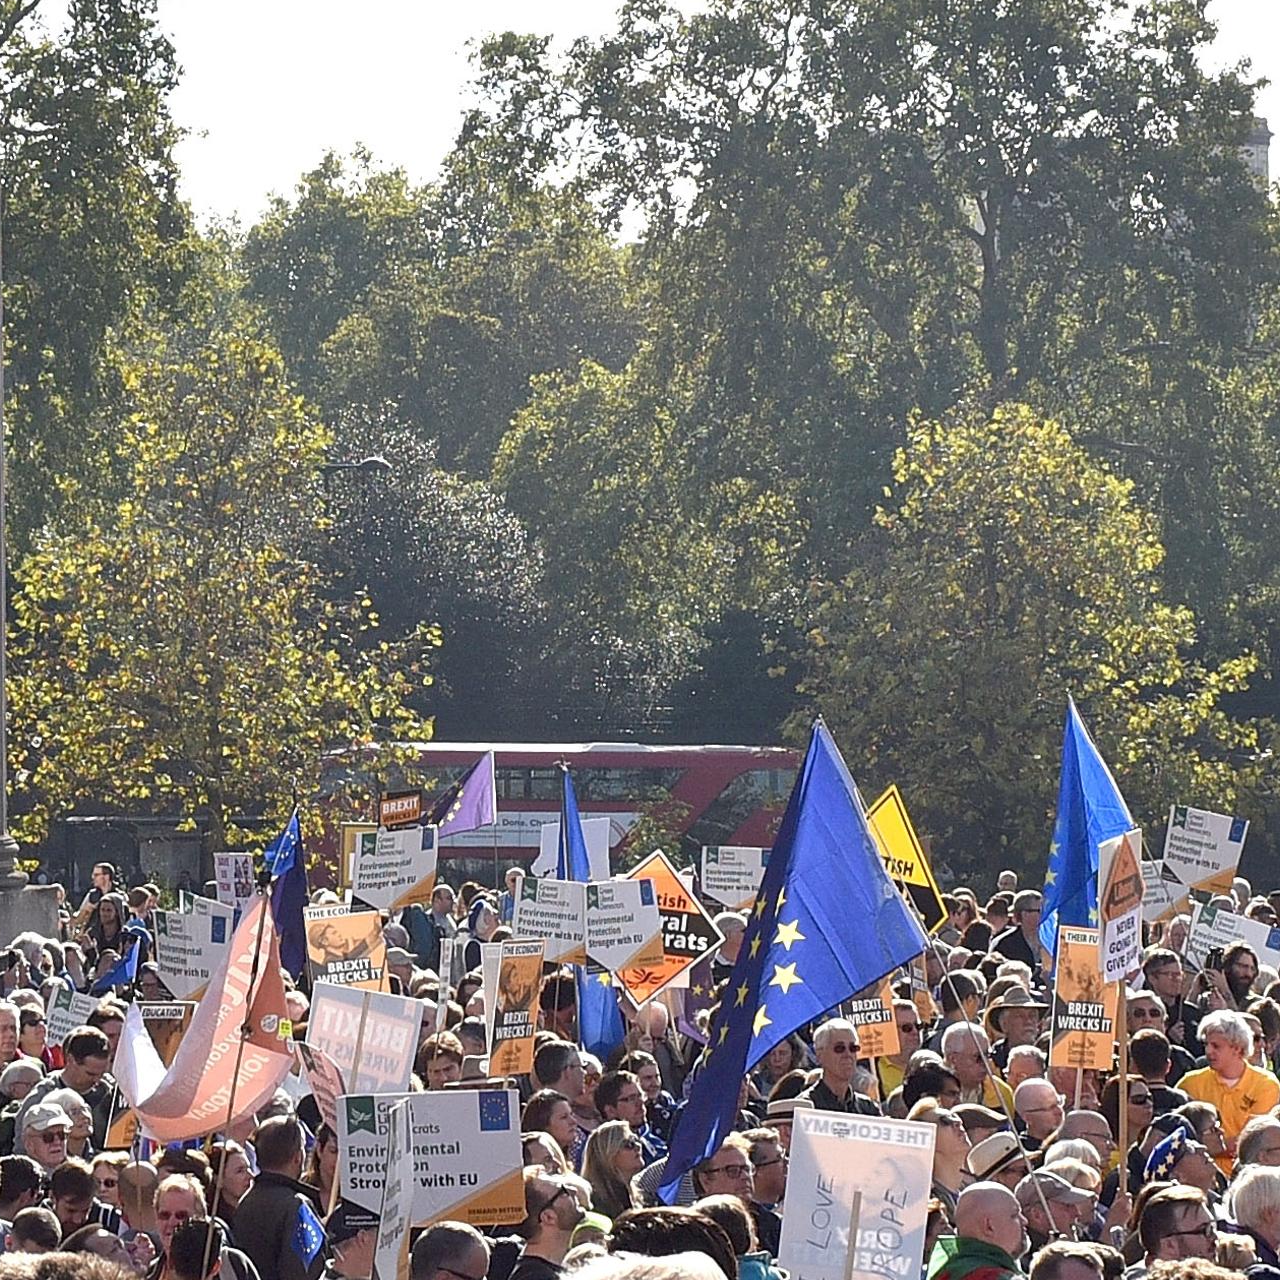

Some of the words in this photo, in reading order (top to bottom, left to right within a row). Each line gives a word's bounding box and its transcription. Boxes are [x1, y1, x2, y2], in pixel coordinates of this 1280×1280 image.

[383, 796, 419, 814] BREXIT
[882, 855, 914, 877] TISH
[357, 879, 390, 890] Stronger
[658, 894, 687, 909] tish
[308, 910, 325, 919] THE
[519, 907, 578, 921] Environmental
[587, 914, 634, 927] Environmental
[518, 918, 560, 929] Protection
[517, 927, 552, 939] Stronger
[573, 932, 583, 941] EU
[588, 926, 621, 937] Protection
[1067, 933, 1087, 942] THEIR
[504, 946, 515, 954] THE
[515, 943, 542, 953] ECONOMY
[588, 937, 615, 948] Stronger
[633, 935, 643, 943] EU
[328, 958, 370, 974] BREXIT
[1107, 955, 1125, 972] GIVE
[318, 970, 369, 985] WRECKS
[371, 968, 382, 980] IT
[852, 999, 882, 1011] BREXIT
[1068, 1002, 1104, 1018] BREXIT
[141, 1008, 183, 1017] EDUCATION
[503, 1011, 529, 1025] BREXIT
[846, 1011, 881, 1023] WRECKS
[1058, 1016, 1100, 1030] WRECKS
[1102, 1020, 1111, 1032] IT
[496, 1025, 523, 1039] WRECKS
[348, 1141, 461, 1159] Envirmental
[420, 1174, 455, 1187] with
[459, 1173, 478, 1186] EU
[806, 1174, 835, 1249] LOVE
